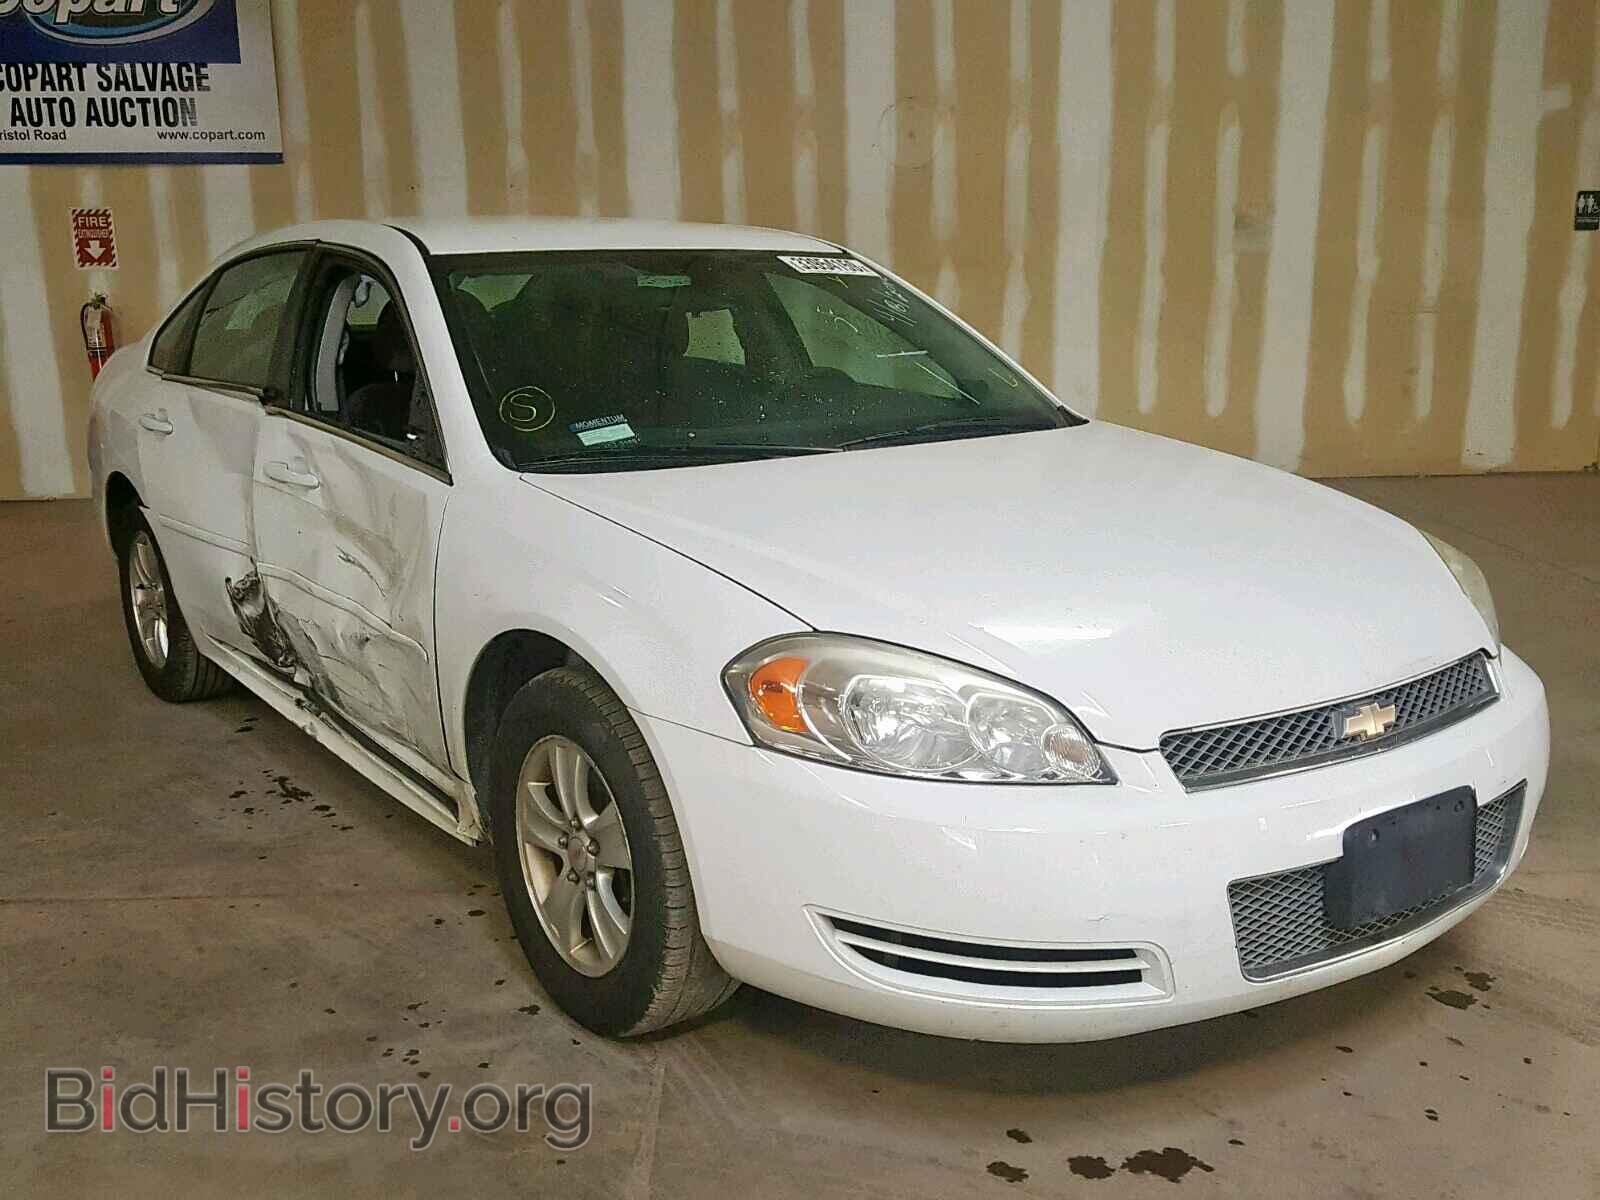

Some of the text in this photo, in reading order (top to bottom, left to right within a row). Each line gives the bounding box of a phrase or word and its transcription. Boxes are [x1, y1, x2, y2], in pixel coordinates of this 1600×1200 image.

[97, 63, 210, 92] SALVAGE
[11, 97, 197, 128] AUTO AUCTION
[34, 129, 67, 141] Road
[157, 129, 265, 142] www.copart.com
[78, 216, 108, 227] FIRE
